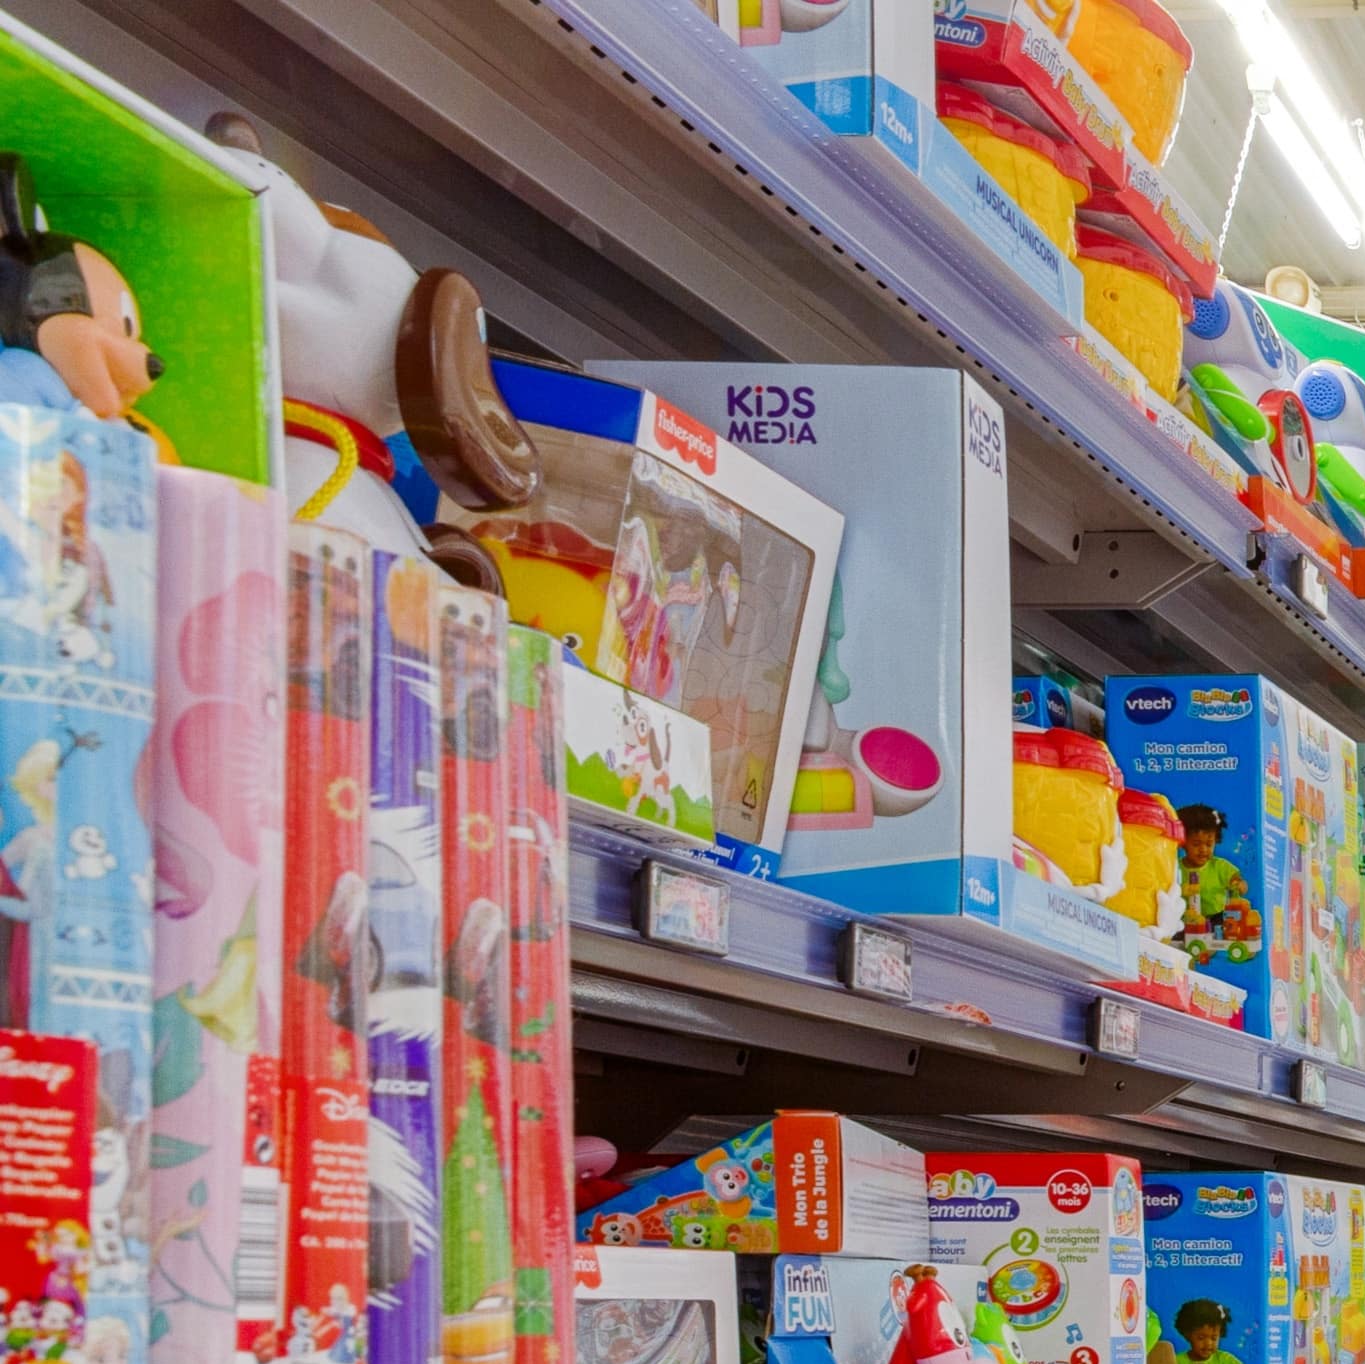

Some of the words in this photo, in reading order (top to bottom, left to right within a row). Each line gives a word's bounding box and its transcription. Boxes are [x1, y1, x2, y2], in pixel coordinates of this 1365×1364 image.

[976, 176, 1017, 232] MUSICAL
[1019, 226, 1059, 275] UNICORN
[655, 407, 715, 459] fisher-price
[1126, 698, 1174, 710] vtech
[1144, 743, 1174, 755] Mon
[1176, 743, 1226, 754] camion
[1164, 758, 1173, 770] 3
[1176, 758, 1238, 770] interactif
[1047, 894, 1081, 926] MUSICAL
[1080, 907, 1118, 938] UNICORN
[791, 1152, 807, 1184] Trio
[812, 1138, 830, 1200] Jungle
[1051, 1183, 1089, 1195] 10-36
[793, 1190, 809, 1227] Mon
[929, 1202, 1014, 1218] ementoni.
[1058, 1197, 1081, 1206] mois
[815, 1205, 828, 1218] la
[816, 1222, 830, 1241] de
[1153, 1238, 1178, 1250] Mon
[1182, 1238, 1231, 1250] camion
[1183, 1253, 1243, 1266] interactif
[786, 1264, 830, 1294] infini
[786, 1296, 834, 1329] FUN
